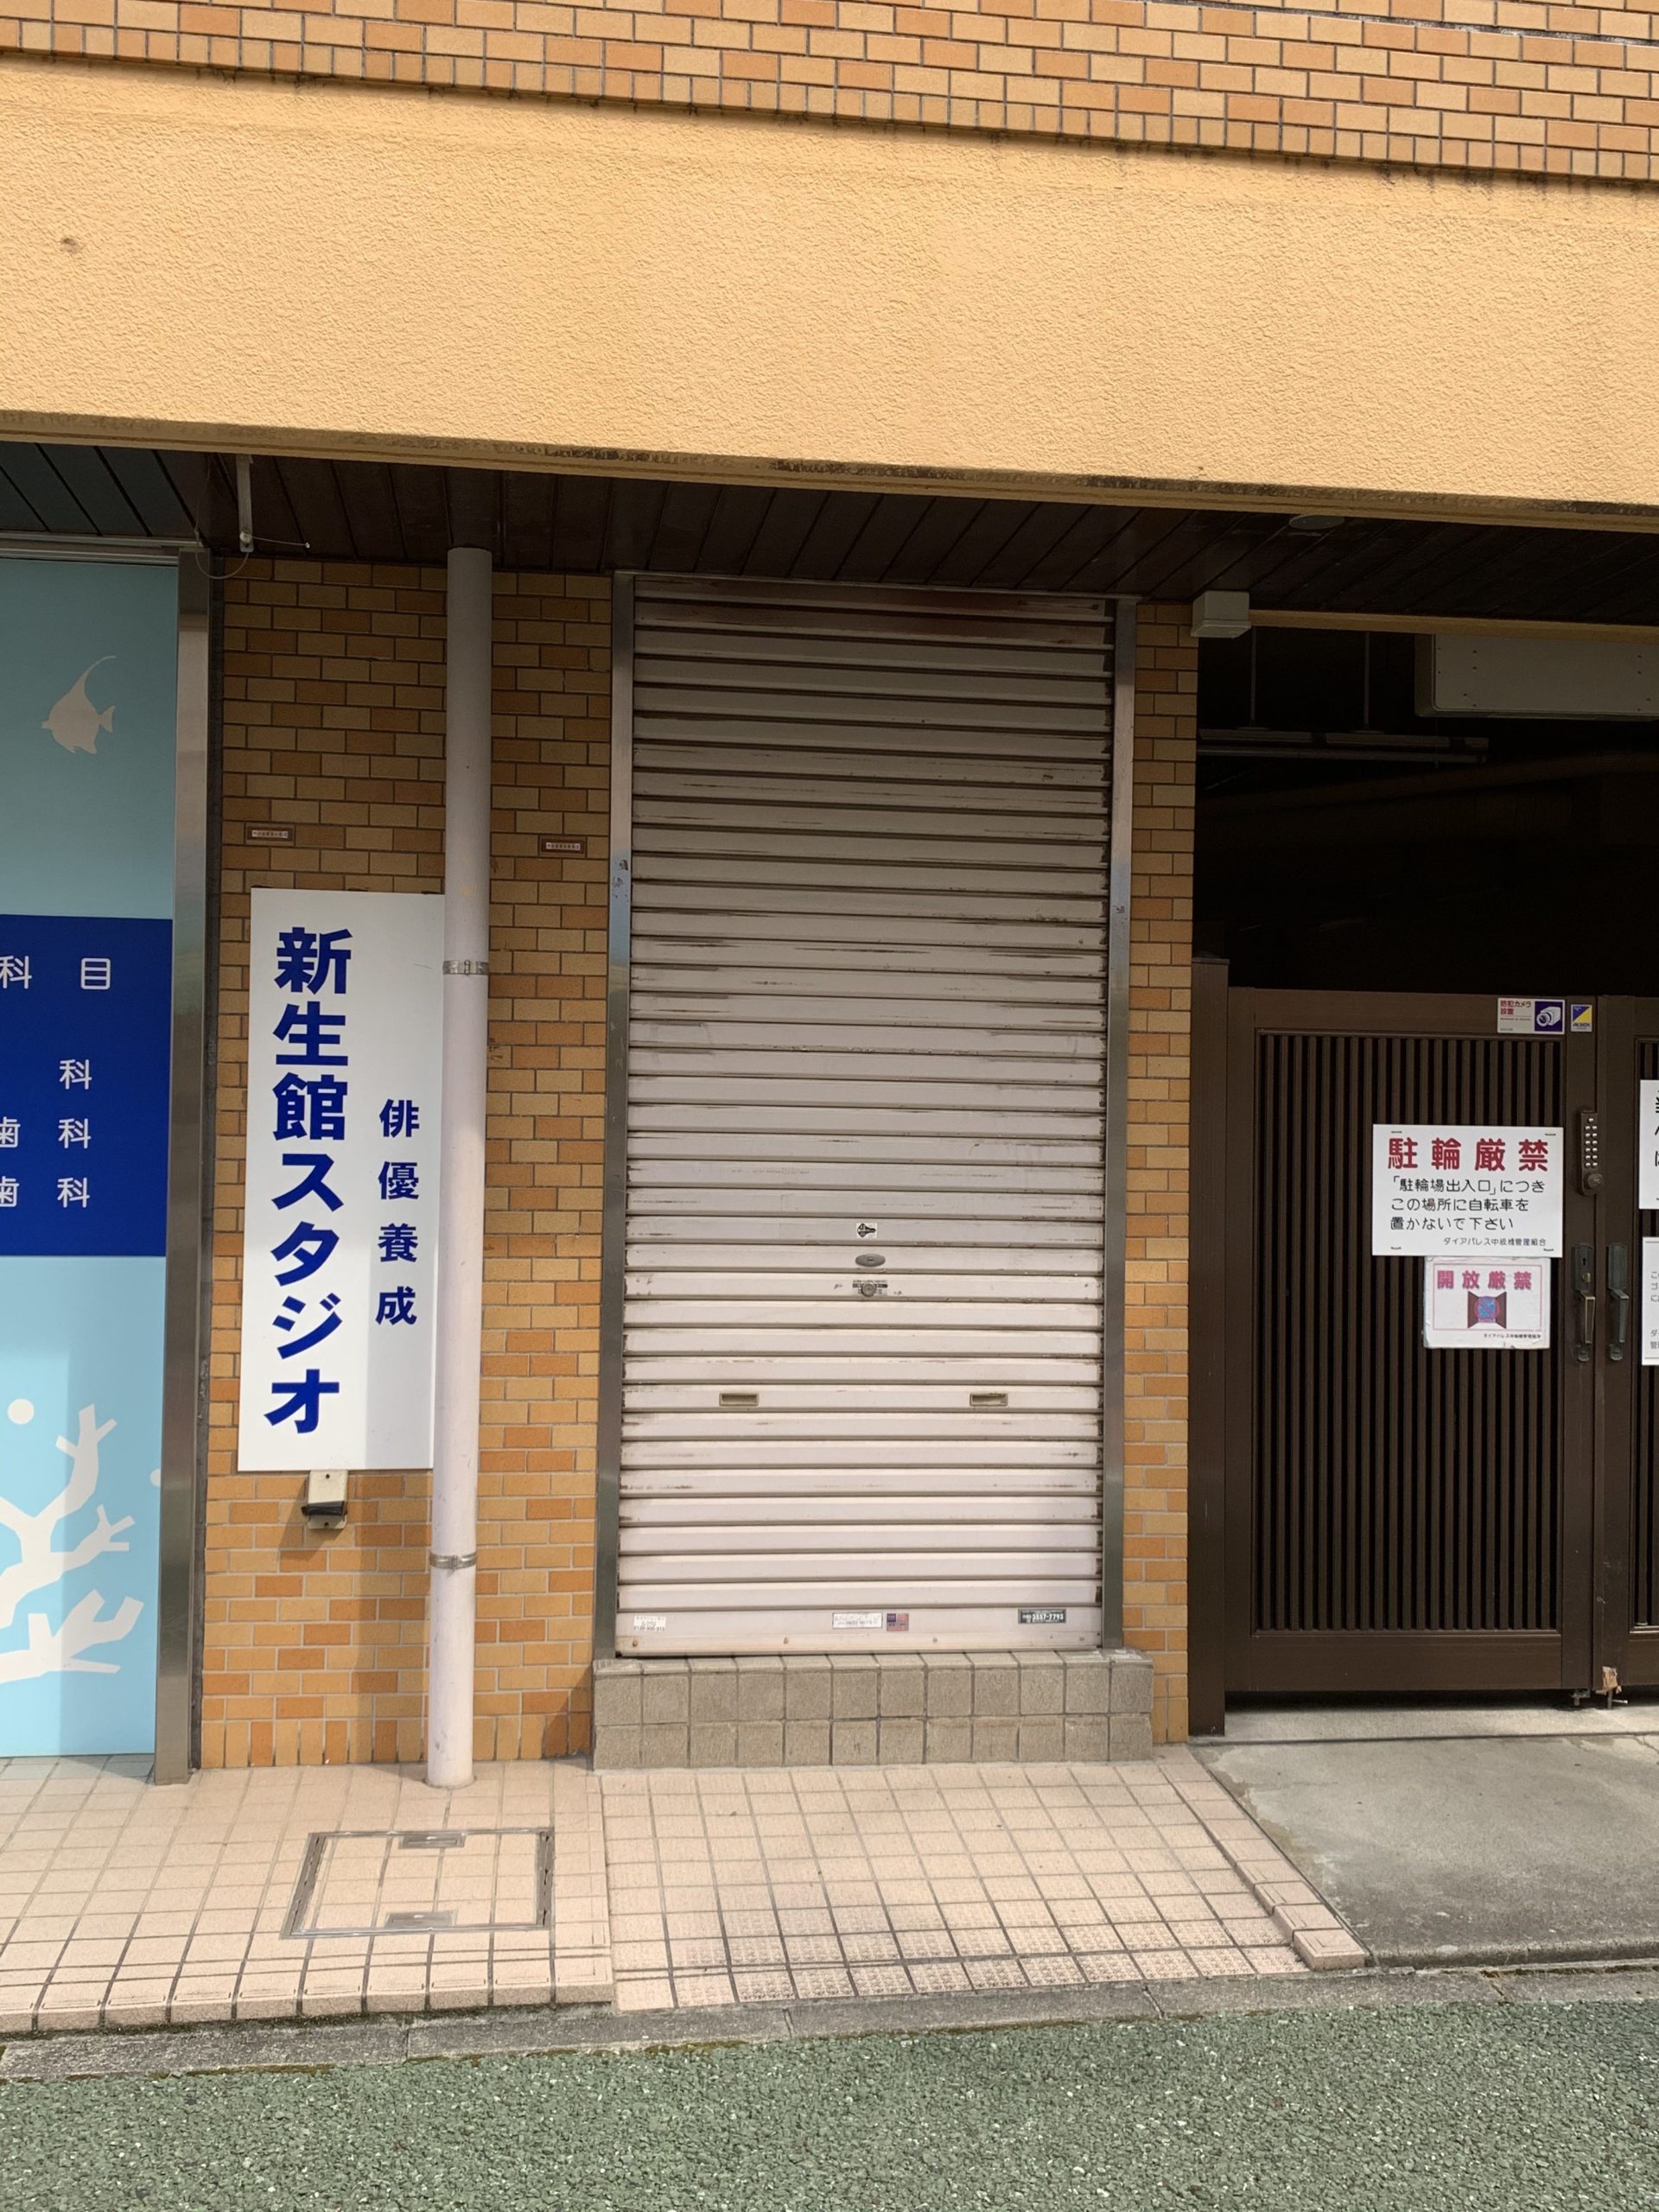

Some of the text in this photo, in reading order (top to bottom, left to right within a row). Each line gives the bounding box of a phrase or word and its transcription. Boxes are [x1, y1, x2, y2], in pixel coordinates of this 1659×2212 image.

[1500, 999, 1532, 1008] 防犯カメラ
[1388, 1137, 1548, 1172] 駐輪厳禁
[264, 926, 353, 1433] 新生館スタジオ
[1393, 1175, 1546, 1195] 「駐輪場出入口」につき
[375, 1099, 421, 1325] 俳優養成
[1390, 1198, 1529, 1212] この場所に自転車を
[1390, 1217, 1514, 1231] 置かないで下さい
[1436, 1270, 1532, 1291] 開放厳禁
